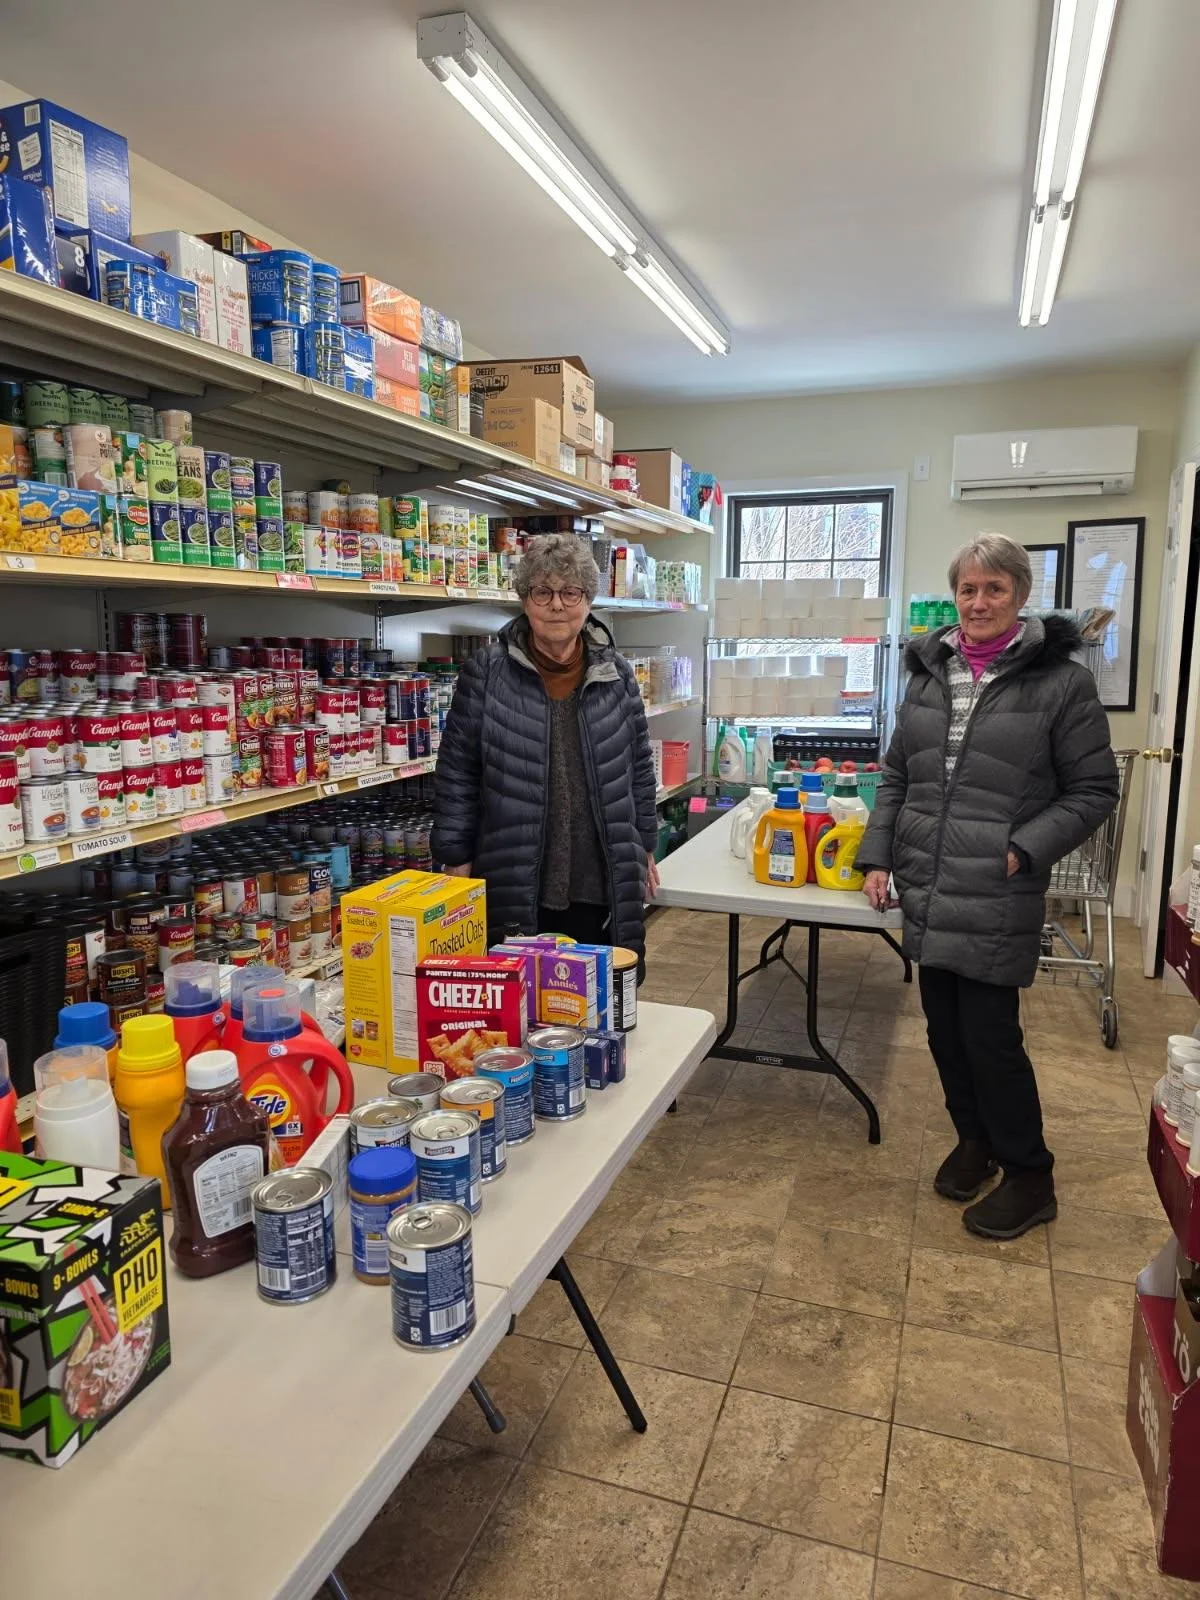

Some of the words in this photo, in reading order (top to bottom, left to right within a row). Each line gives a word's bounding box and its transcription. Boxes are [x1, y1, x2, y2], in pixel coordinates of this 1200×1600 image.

[535, 364, 560, 374] 12641
[177, 465, 202, 478] EANS
[16, 557, 24, 568] 3
[76, 838, 108, 852] TOMATO
[109, 834, 127, 846] SOUP
[429, 923, 465, 956] Toasted
[464, 918, 485, 945] Oats
[111, 965, 136, 978] BUSH'S
[471, 971, 486, 979] 75%
[547, 977, 579, 991] Annie's
[428, 980, 505, 1010] CHEEZ-IT
[250, 1095, 287, 1114] Tde
[119, 1247, 158, 1304] PHO
[122, 1286, 159, 1321] VIETNAMESE
